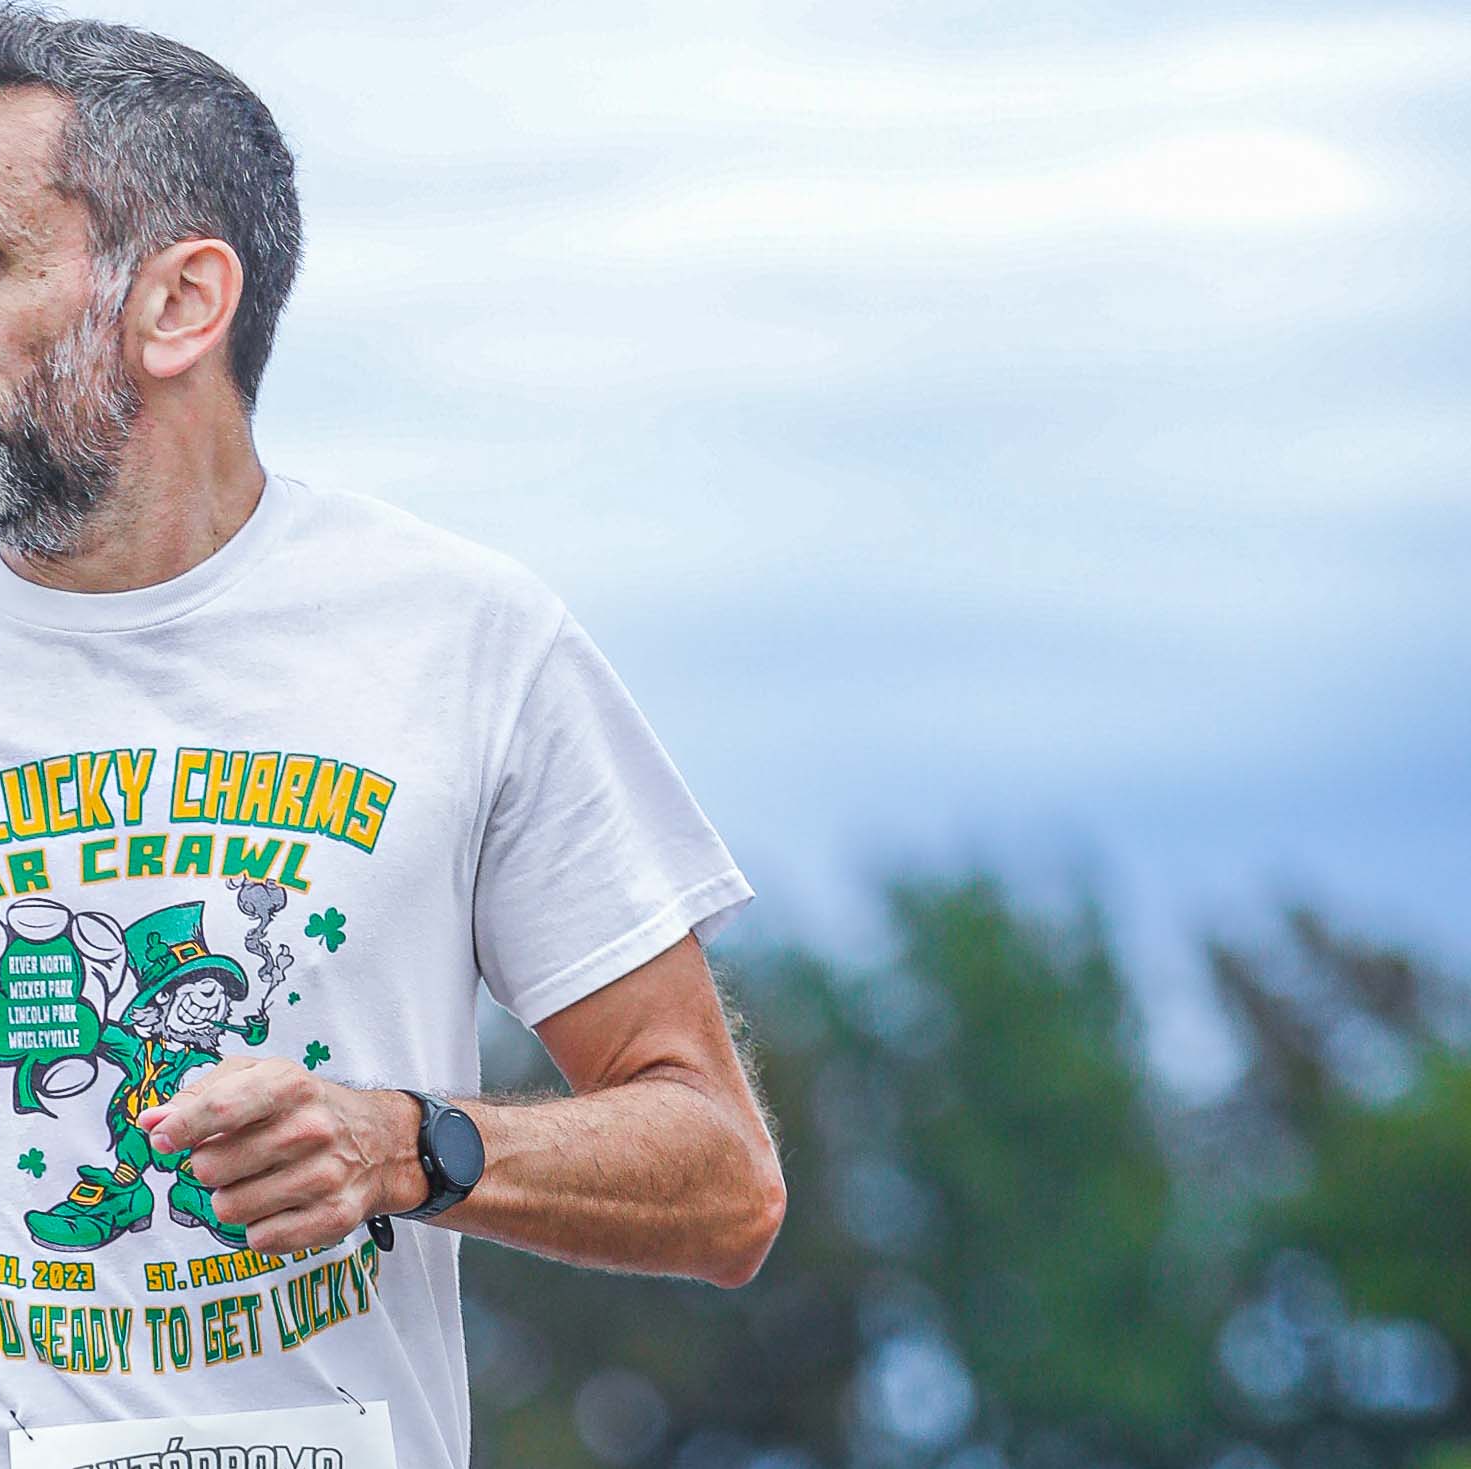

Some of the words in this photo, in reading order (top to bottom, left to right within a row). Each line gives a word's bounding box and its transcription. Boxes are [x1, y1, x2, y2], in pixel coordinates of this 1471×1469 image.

[170, 747, 396, 855] CHARMS
[80, 834, 312, 893] CRAWL
[9, 955, 38, 974] RIVER
[39, 955, 72, 973] NORTH
[9, 980, 46, 999] WICKER
[48, 979, 74, 998] PARK
[8, 1005, 50, 1024] LINCOLN
[52, 1004, 78, 1022] PARK
[8, 1028, 80, 1049] WRIGLEYVILLE
[32, 1260, 96, 1292] 2023
[144, 1261, 189, 1291] ST.
[28, 1303, 135, 1375] READY
[145, 1304, 192, 1375] TO
[203, 1293, 264, 1367] GET
